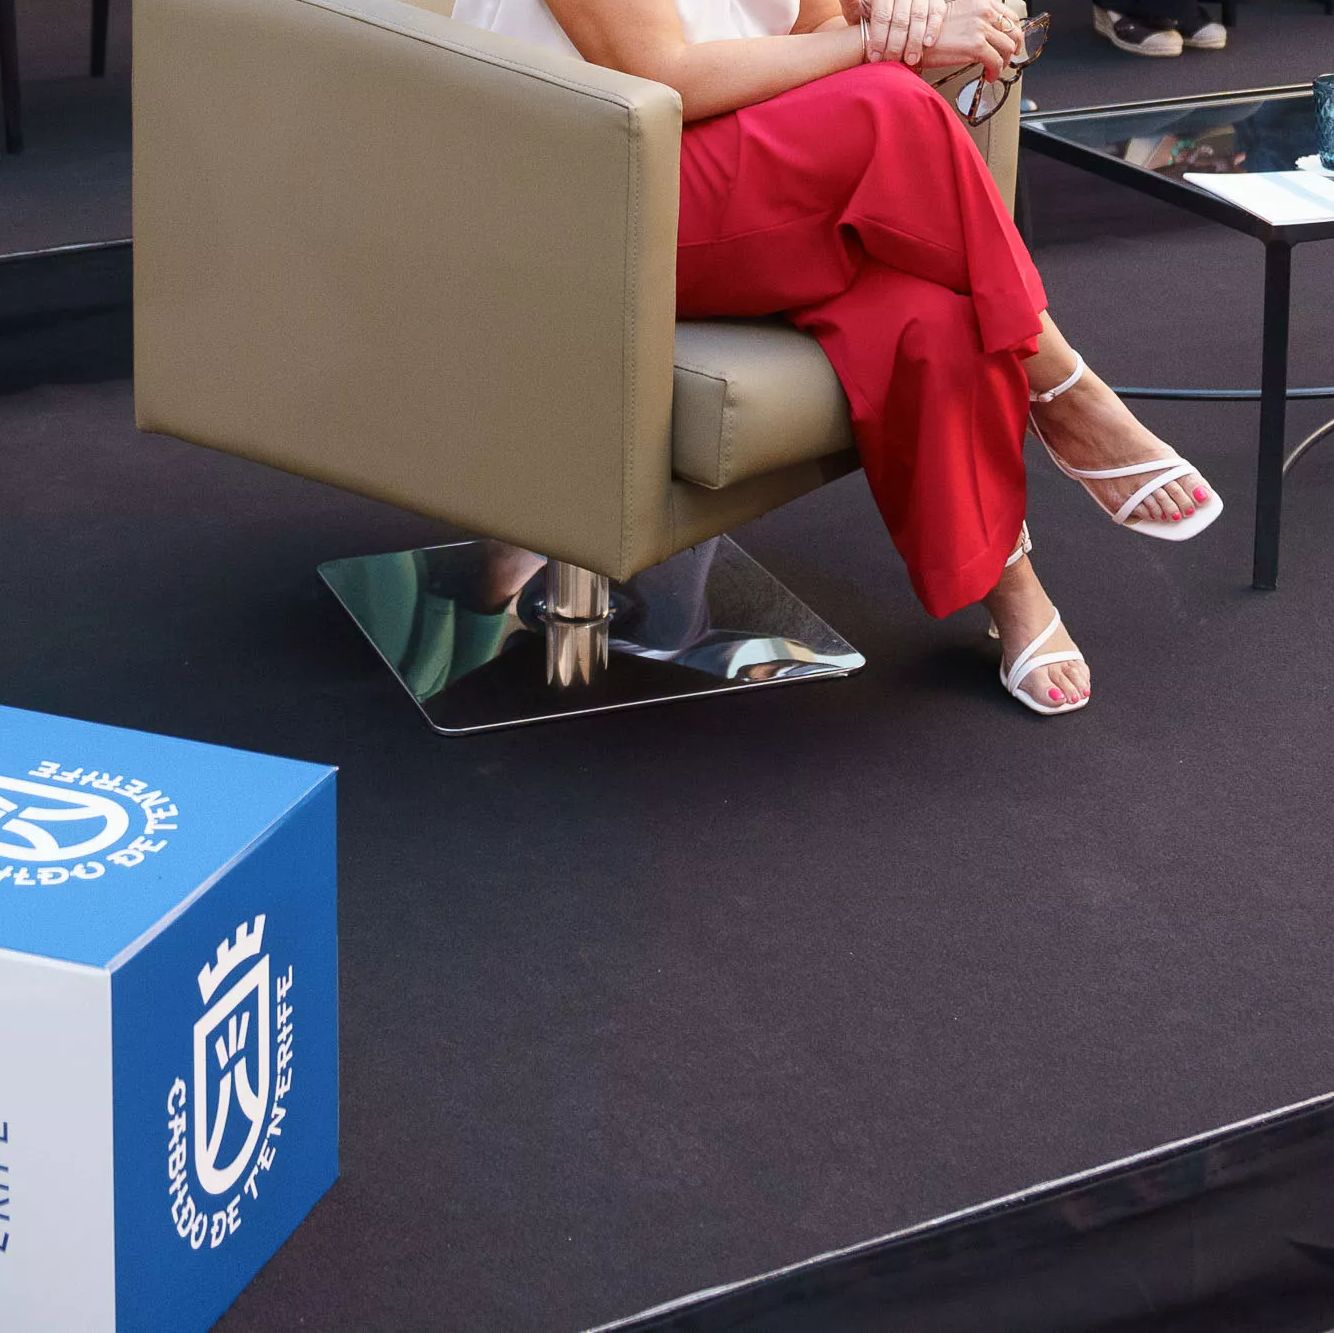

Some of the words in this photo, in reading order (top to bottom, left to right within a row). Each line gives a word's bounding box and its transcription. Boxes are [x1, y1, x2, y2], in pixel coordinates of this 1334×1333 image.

[28, 761, 178, 834] TENERIFE
[107, 836, 167, 867] DE
[224, 965, 293, 1200] TENERIFE
[167, 1076, 207, 1249] CABILDO
[211, 1194, 241, 1248] DE
